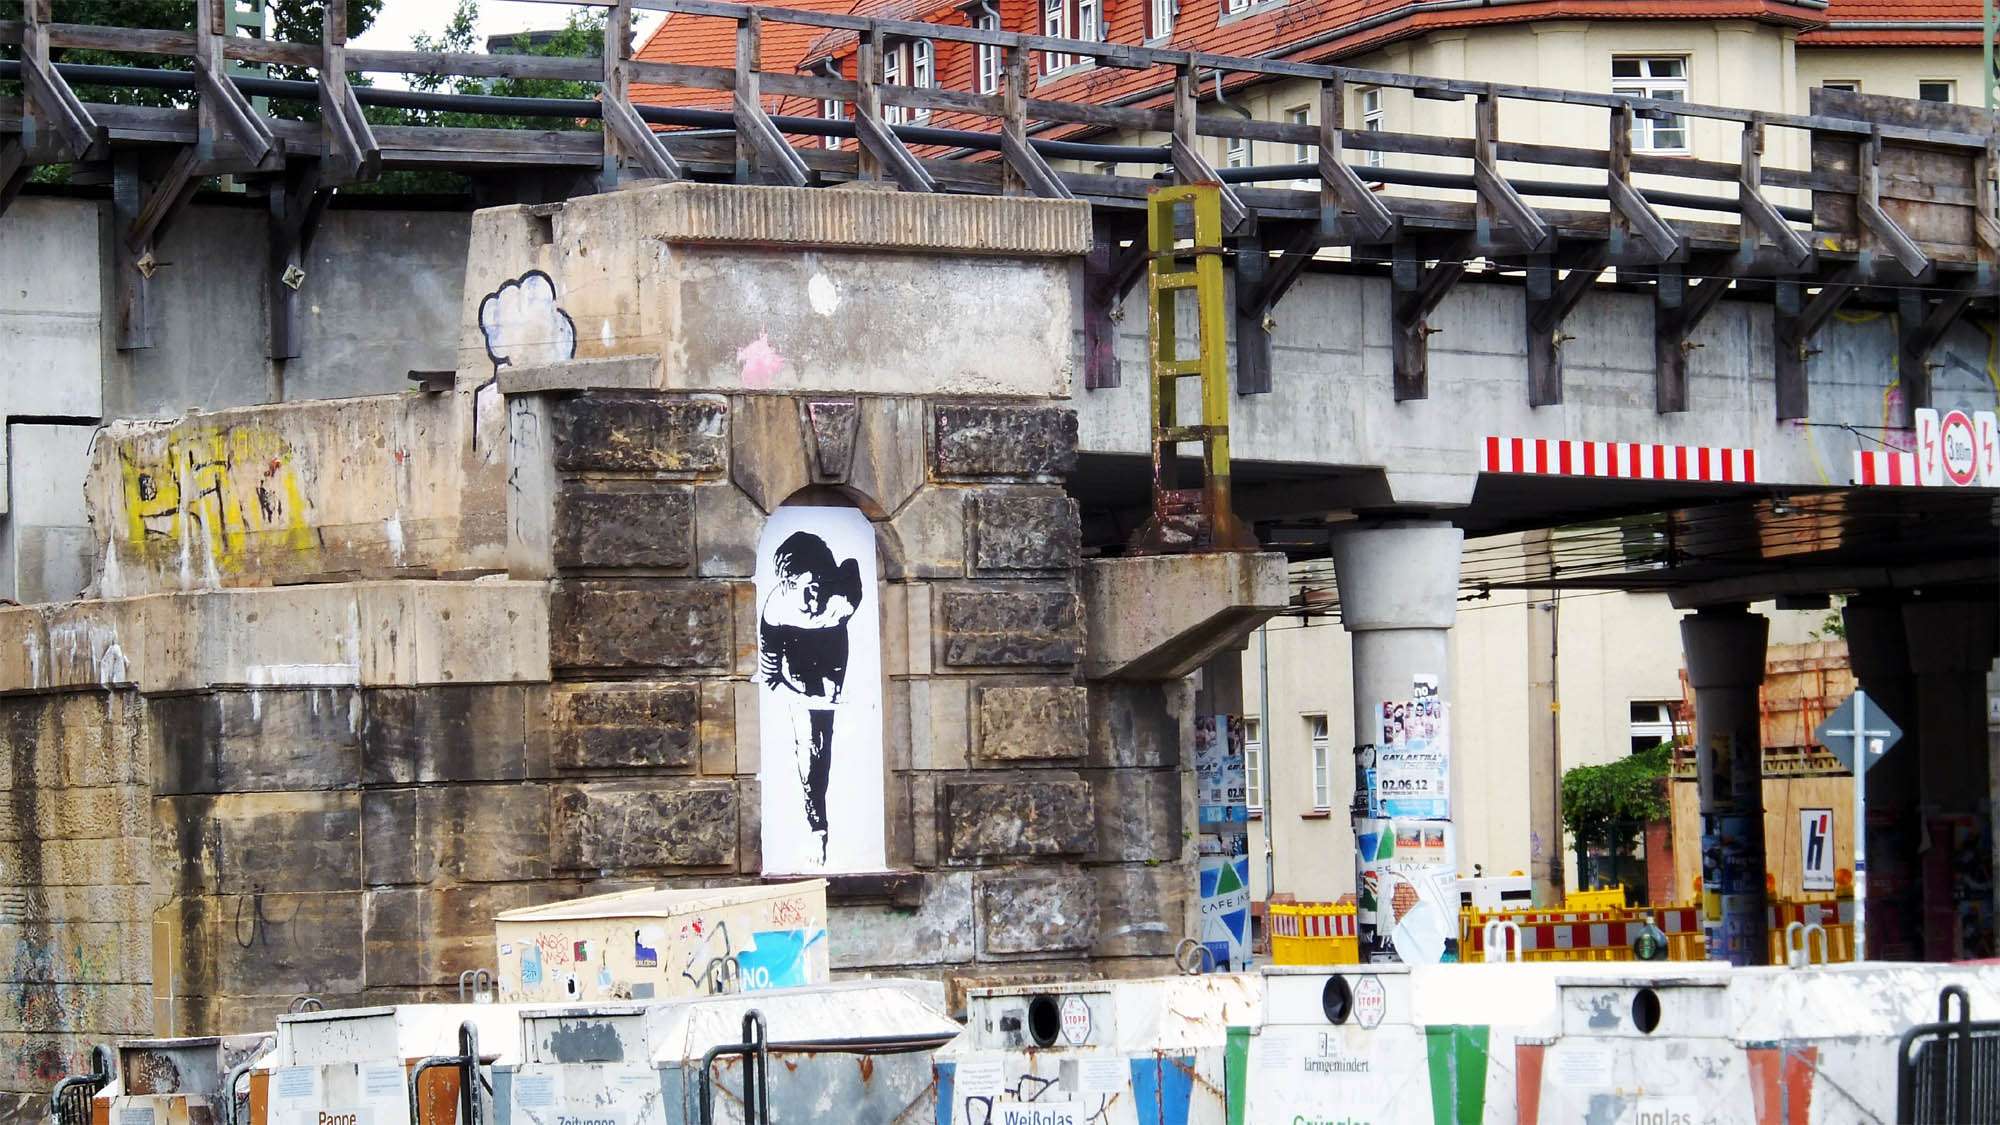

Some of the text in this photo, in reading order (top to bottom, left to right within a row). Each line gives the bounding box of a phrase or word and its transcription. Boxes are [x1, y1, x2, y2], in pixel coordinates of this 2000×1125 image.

[1382, 780, 1428, 790] 02.06.12
[1201, 899, 1233, 914] CAFE
[1358, 996, 1381, 1008] STOPP
[1065, 1015, 1087, 1024] STOPP
[319, 1112, 356, 1125] Pappe
[1005, 1110, 1073, 1125] Weißglas
